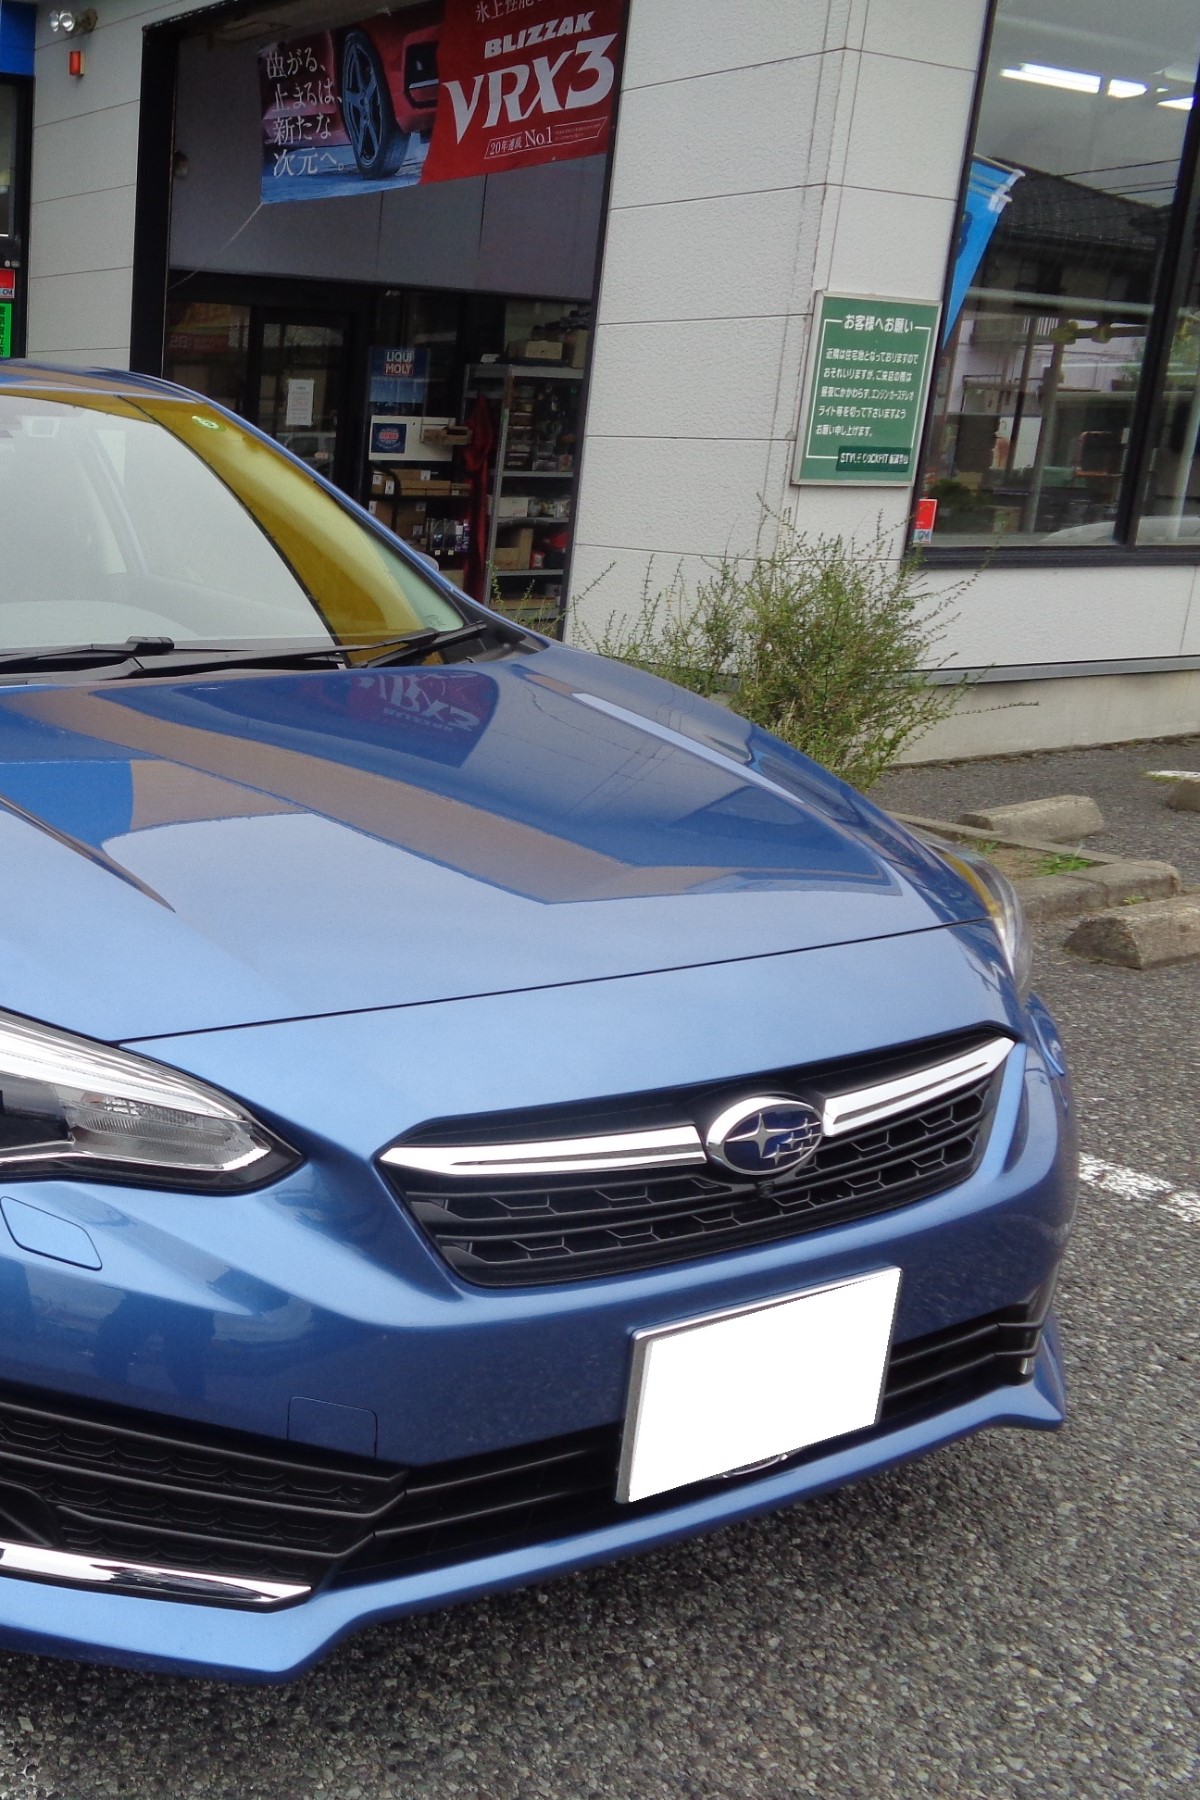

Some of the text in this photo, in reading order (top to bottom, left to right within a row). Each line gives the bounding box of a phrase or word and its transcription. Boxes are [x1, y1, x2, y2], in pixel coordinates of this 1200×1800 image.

[484, 11, 595, 59] BLIZZAK
[443, 33, 618, 145] VRX3
[273, 112, 332, 146] 新たな
[844, 313, 914, 334] お客様へお願い
[385, 363, 413, 375] MOLY
[386, 351, 414, 362] LIQUI
